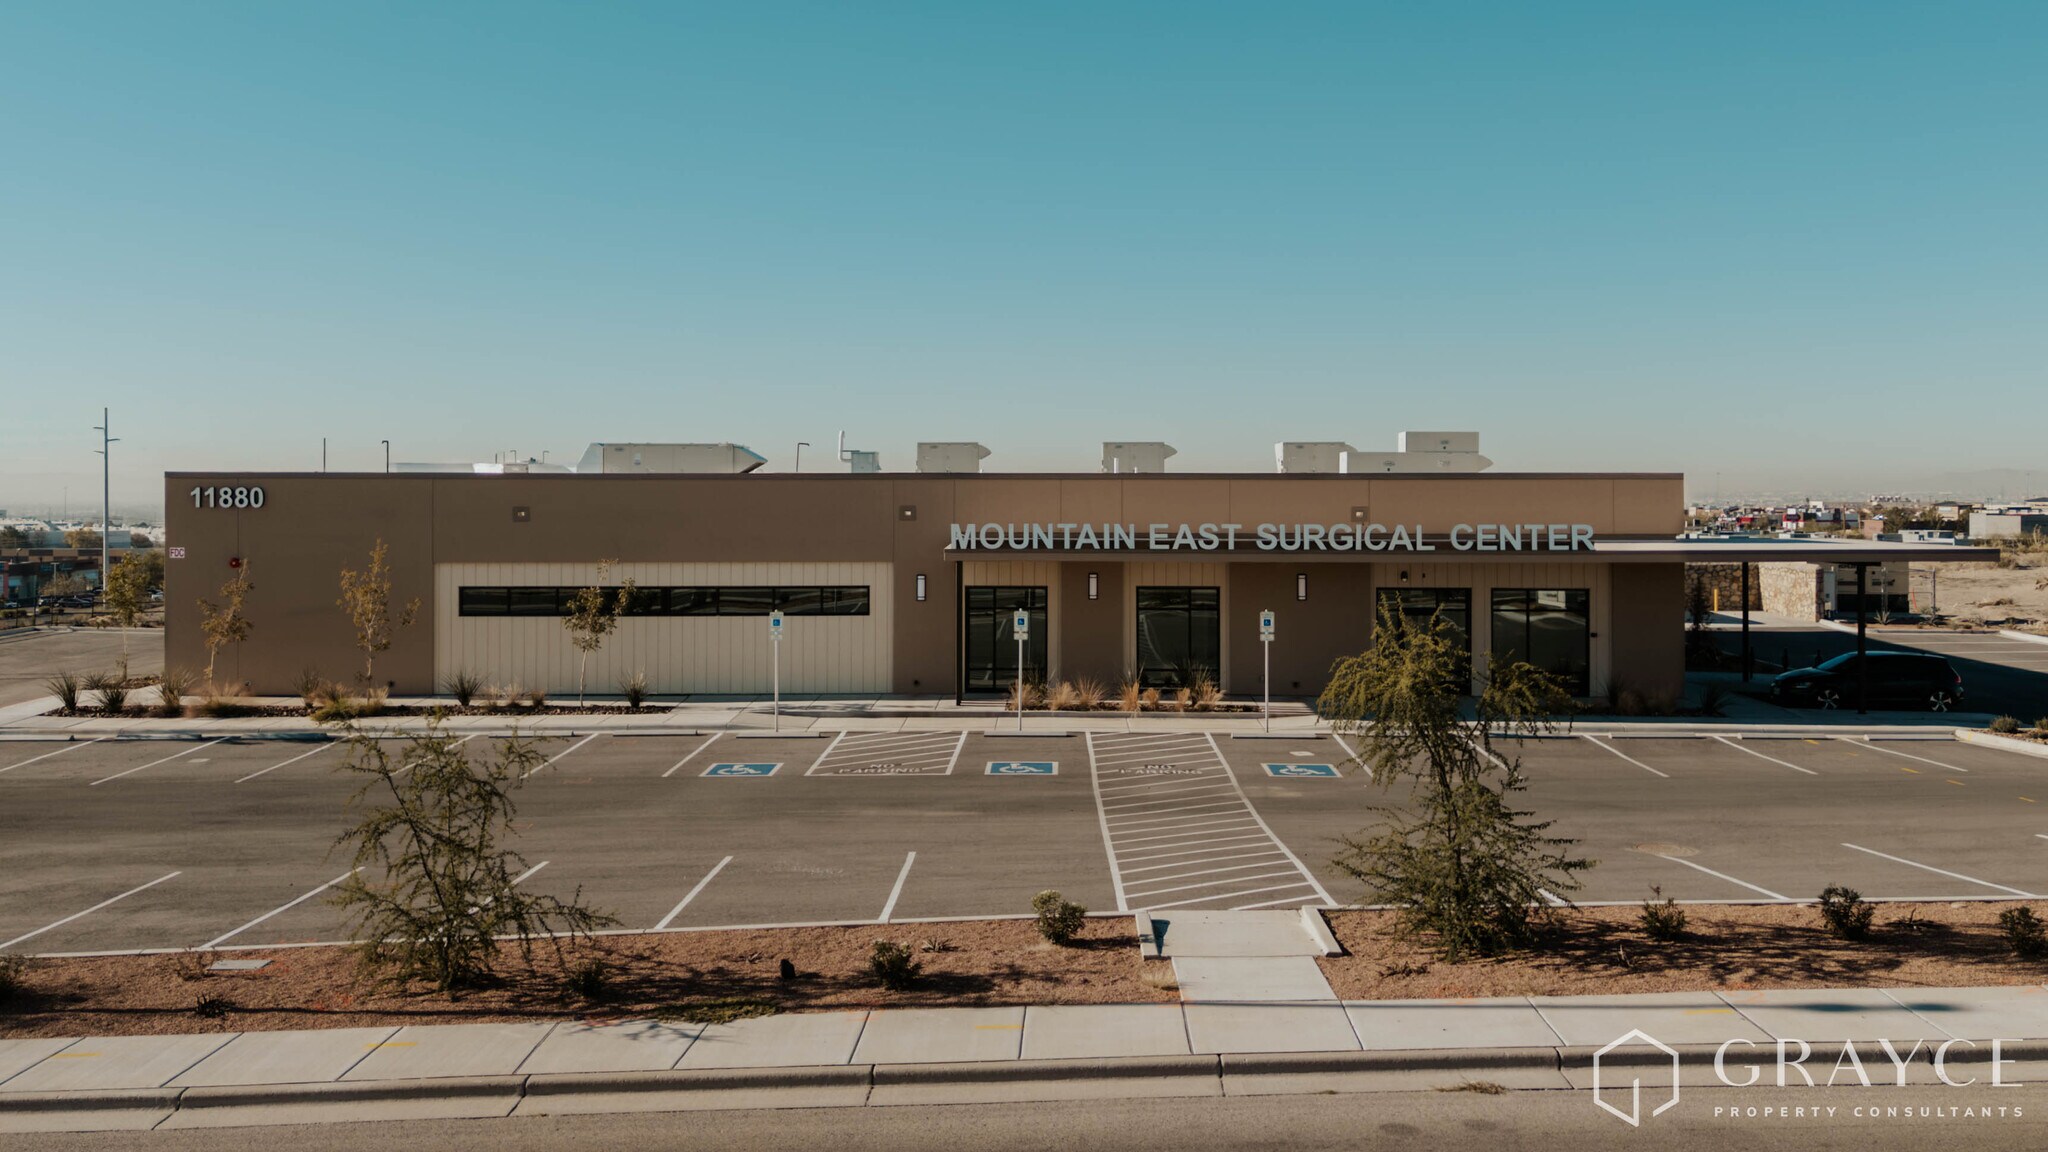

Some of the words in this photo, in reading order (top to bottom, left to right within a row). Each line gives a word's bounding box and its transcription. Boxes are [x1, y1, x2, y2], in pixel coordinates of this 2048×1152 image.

[190, 486, 264, 508] 11880
[950, 523, 1136, 550] MOUNTAIN
[1150, 523, 1242, 550] EAST
[1255, 523, 1436, 550] SURGICAL
[1450, 523, 1595, 550] CENTER
[170, 548, 185, 558] FDC
